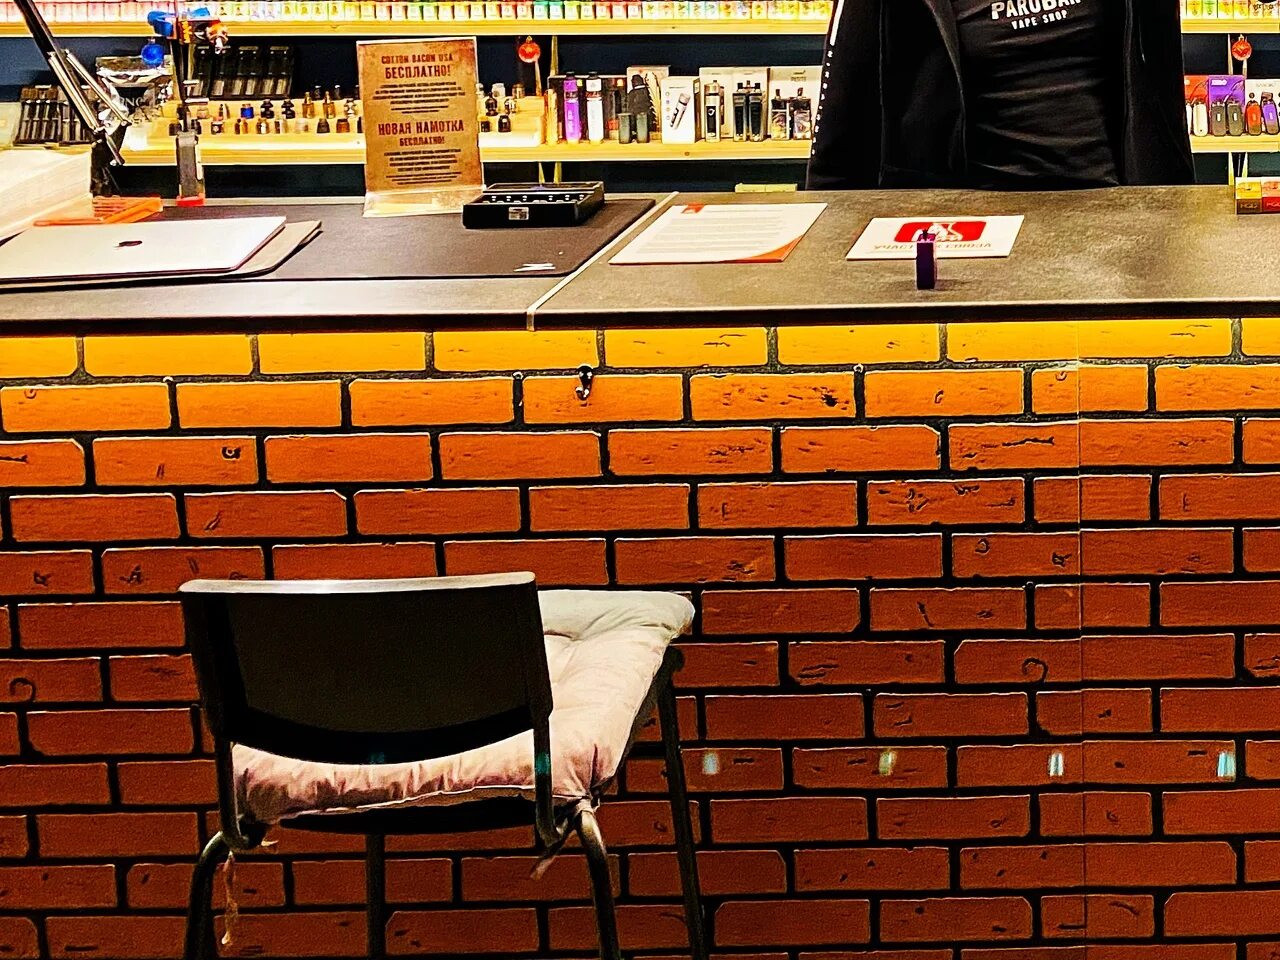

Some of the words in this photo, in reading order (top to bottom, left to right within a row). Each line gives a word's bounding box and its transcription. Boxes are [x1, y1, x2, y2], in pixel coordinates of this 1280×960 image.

[1011, 16, 1038, 29] VAPE
[1042, 9, 1068, 23] SHOP
[381, 55, 409, 64] COTTON
[412, 53, 436, 63] BACON
[439, 53, 453, 62] USA
[385, 64, 451, 79] БЕСПЛАТНО!
[378, 122, 412, 136] НОВАЯ
[416, 119, 464, 134] НАМОТКА
[399, 136, 445, 147] БЕСПЛАТНО!
